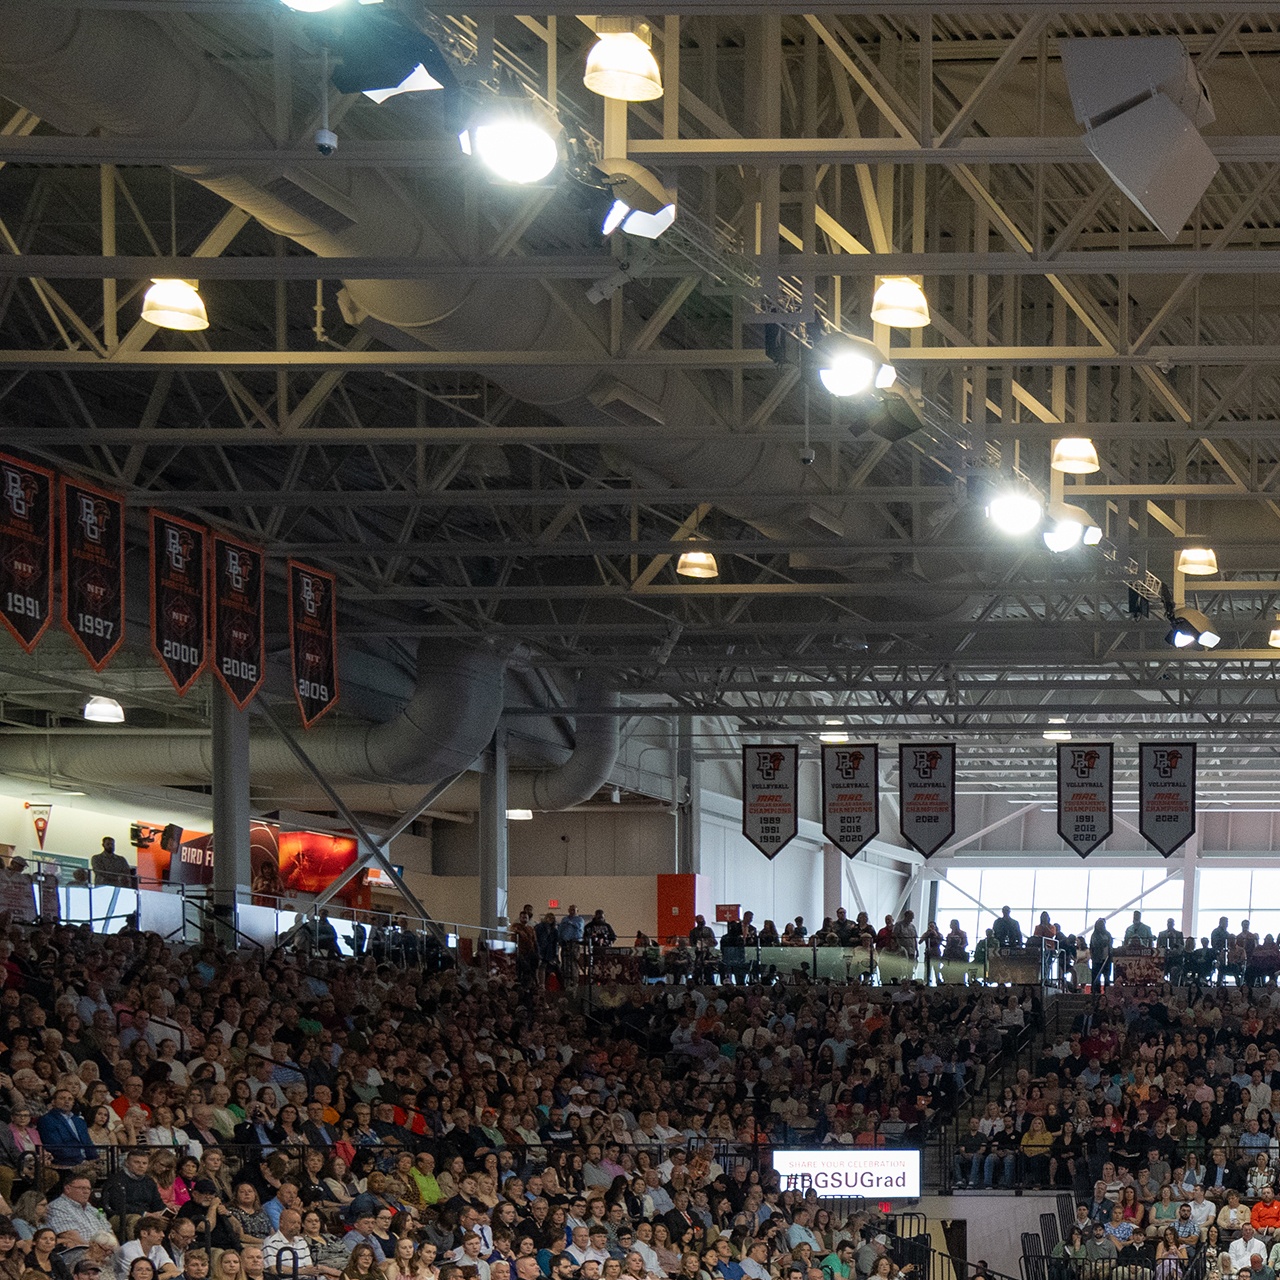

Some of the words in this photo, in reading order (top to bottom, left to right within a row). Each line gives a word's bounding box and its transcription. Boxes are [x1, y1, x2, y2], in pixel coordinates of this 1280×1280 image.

[8, 592, 41, 620] 1991
[78, 613, 114, 640] 1997
[163, 639, 199, 666] 2000
[222, 657, 257, 681] 2002
[299, 678, 329, 701] 2009
[181, 847, 203, 865] BIRD
[787, 1172, 906, 1189] #BGSUGrad
